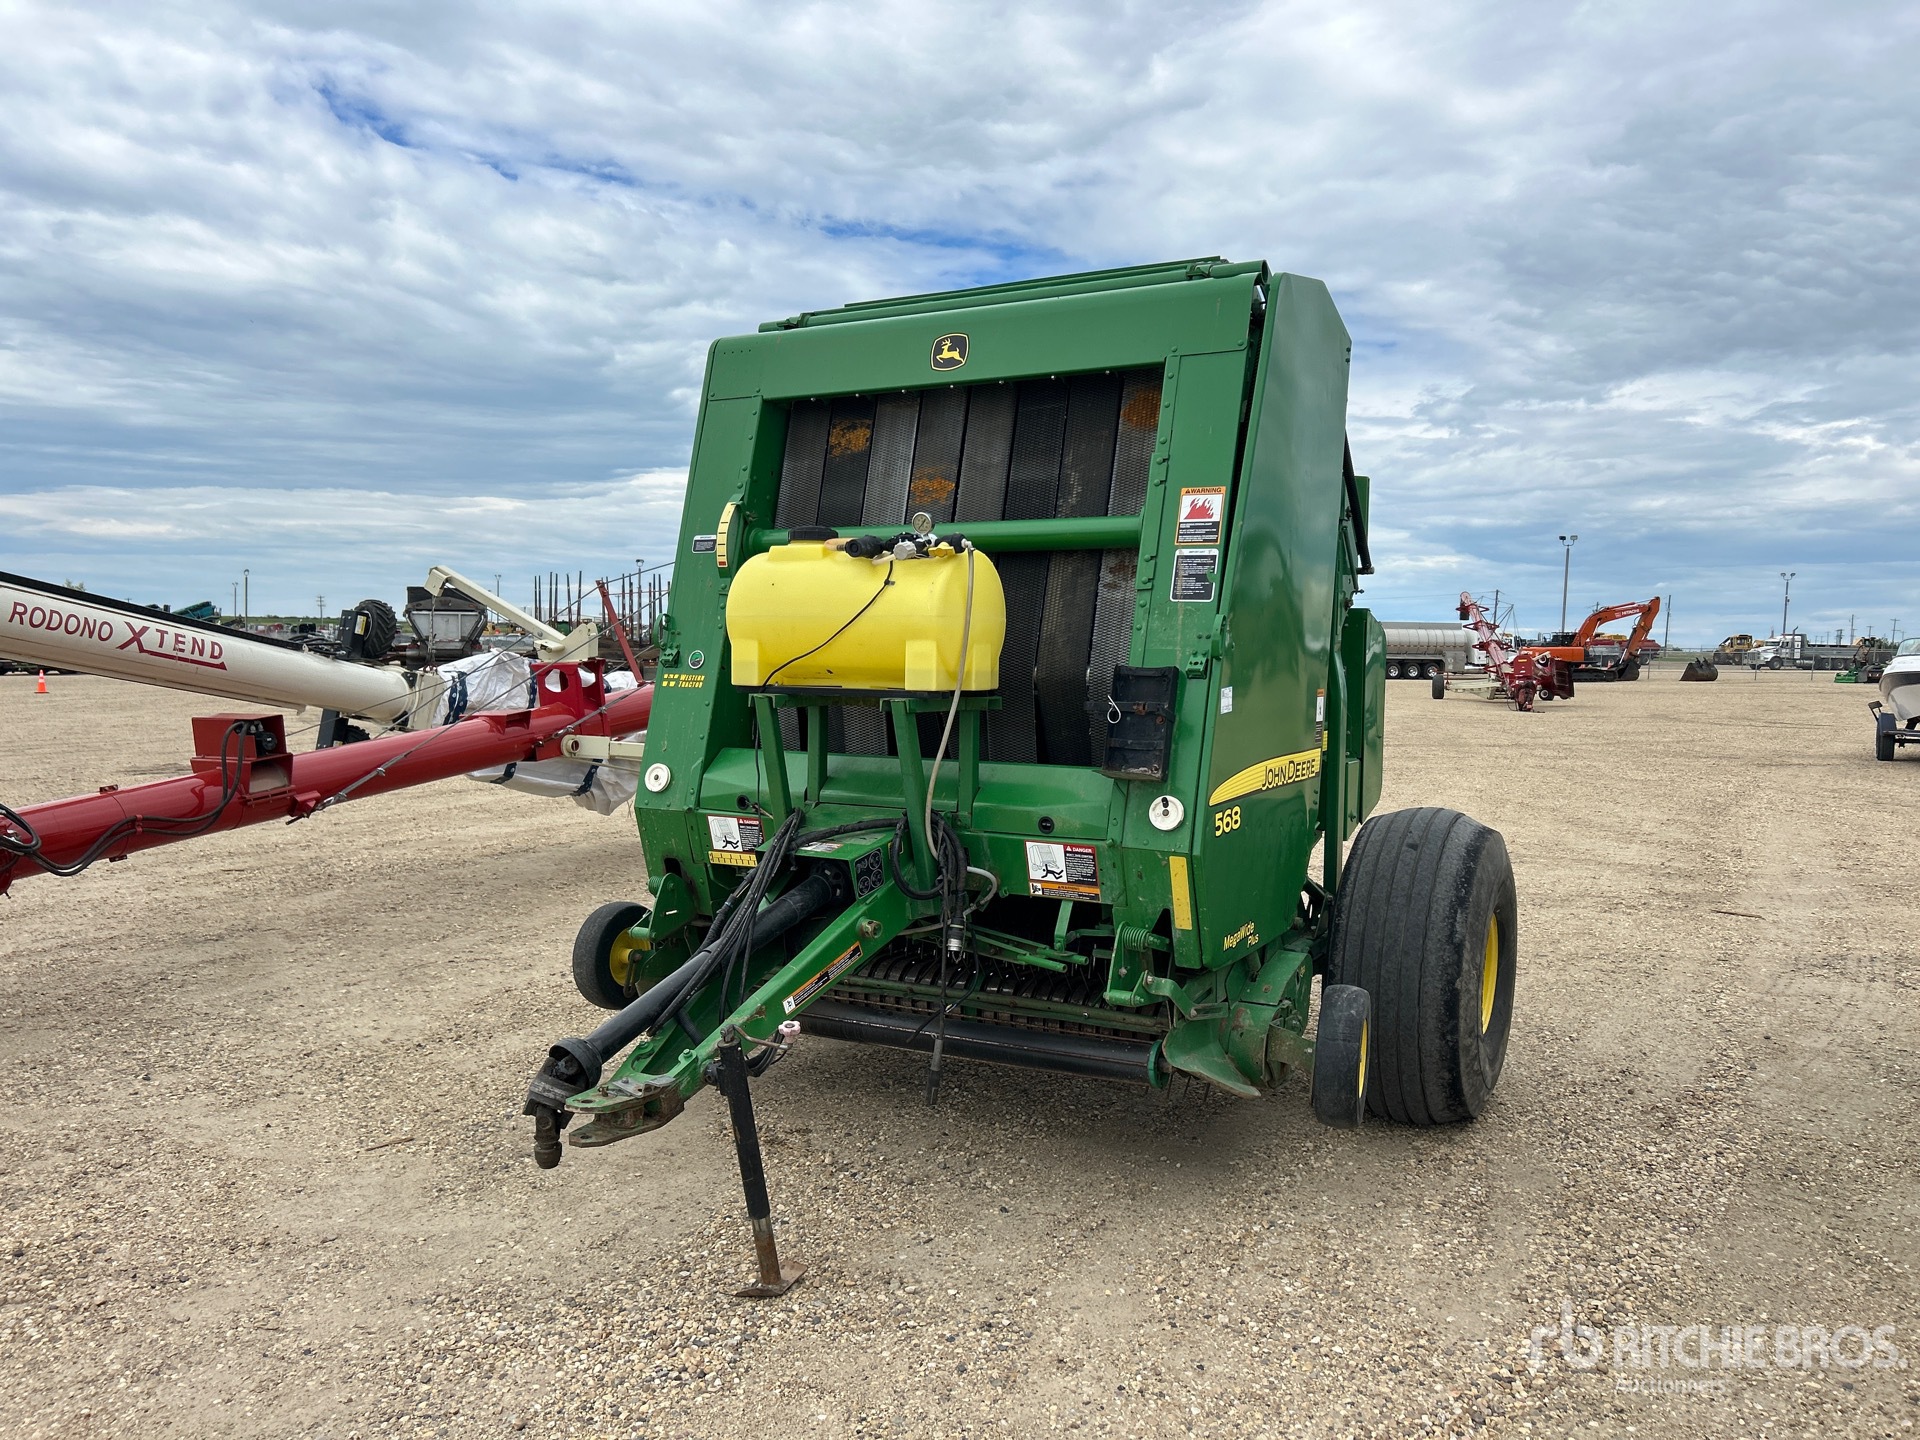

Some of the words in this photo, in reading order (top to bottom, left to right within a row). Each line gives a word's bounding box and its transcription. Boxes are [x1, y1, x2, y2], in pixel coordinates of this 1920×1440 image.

[8, 601, 114, 642] RODONO
[116, 621, 225, 665] XTEND
[1261, 765, 1287, 790] JOHN
[1287, 759, 1317, 783] DEERE
[1215, 806, 1242, 837] 568
[1223, 921, 1256, 952] MegaWide
[1247, 933, 1260, 949] Plus
